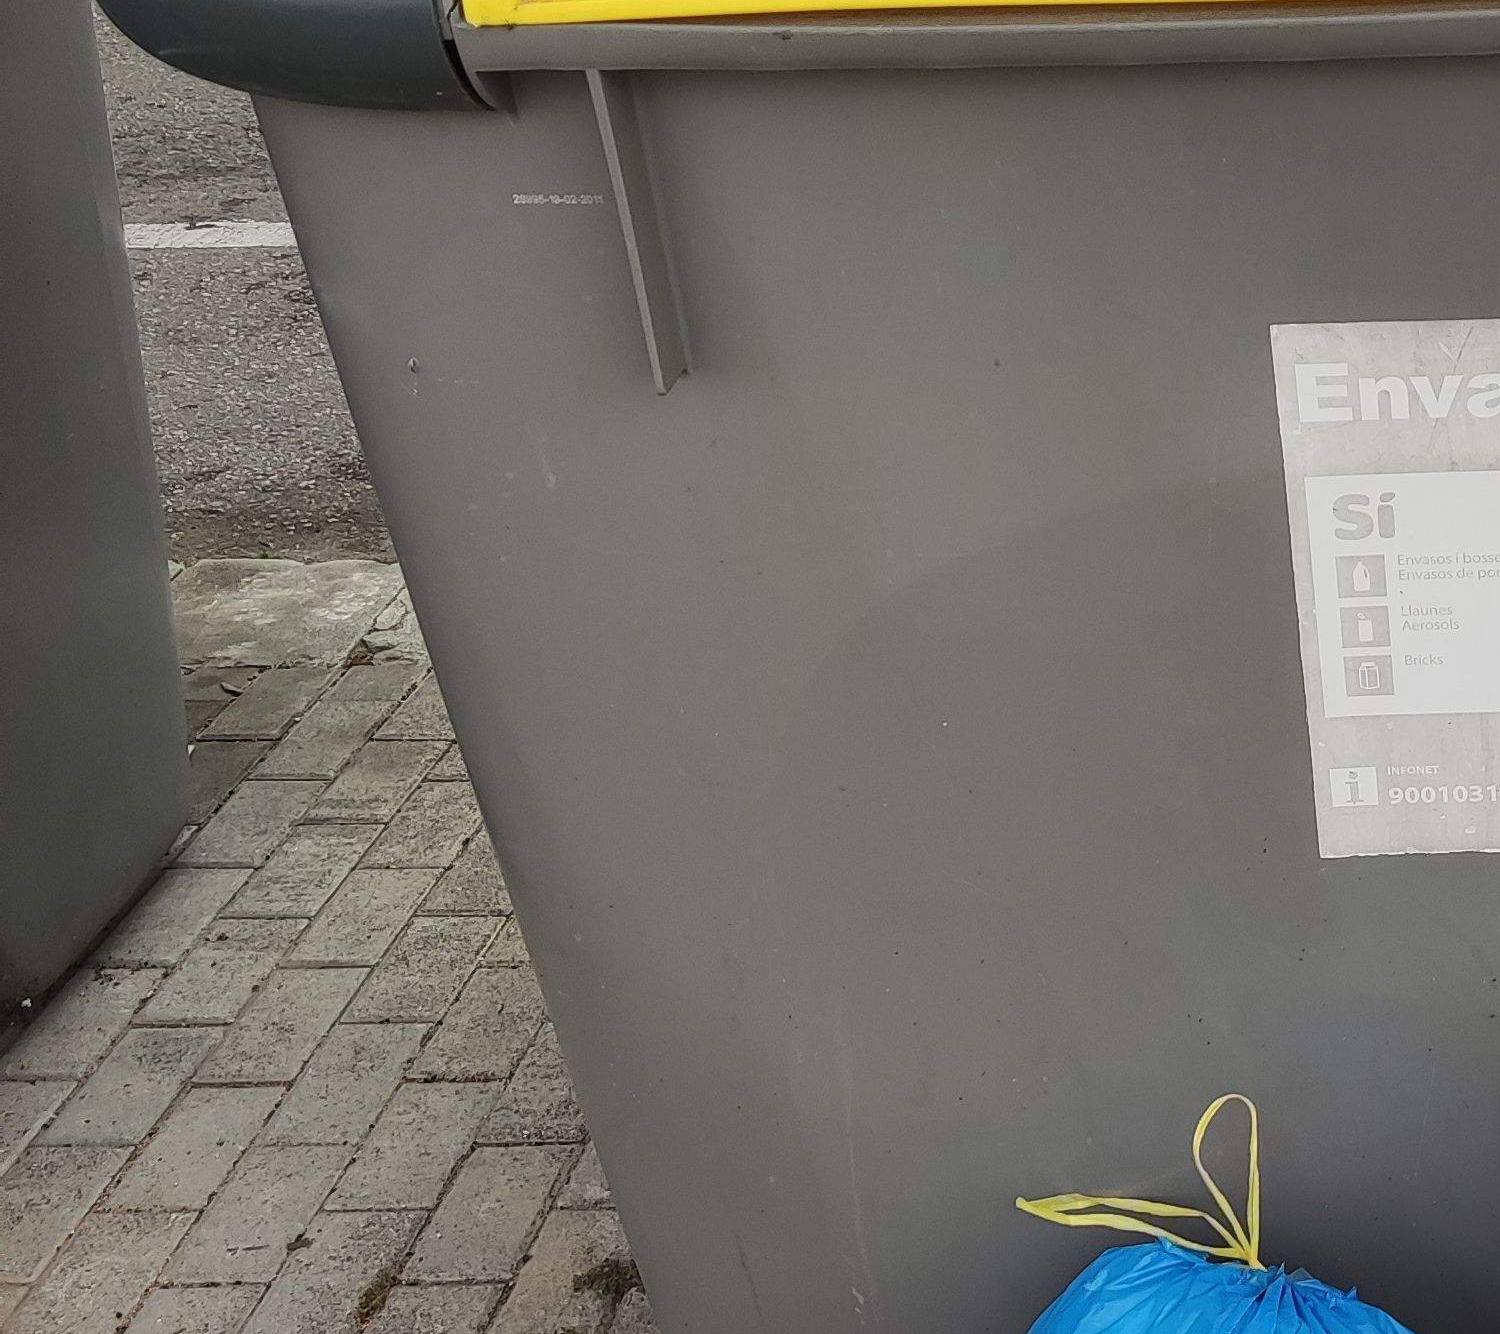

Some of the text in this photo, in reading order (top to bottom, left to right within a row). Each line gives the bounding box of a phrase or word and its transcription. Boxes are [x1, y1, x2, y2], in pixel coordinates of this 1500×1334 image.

[1397, 553, 1451, 566] Envasos
[1398, 568, 1453, 581] Envasos
[1456, 566, 1474, 579] de
[1400, 603, 1453, 617] Llaunes
[1402, 618, 1461, 632] Aerosols
[1404, 653, 1444, 667] Bricks
[1387, 766, 1440, 775] INFONET
